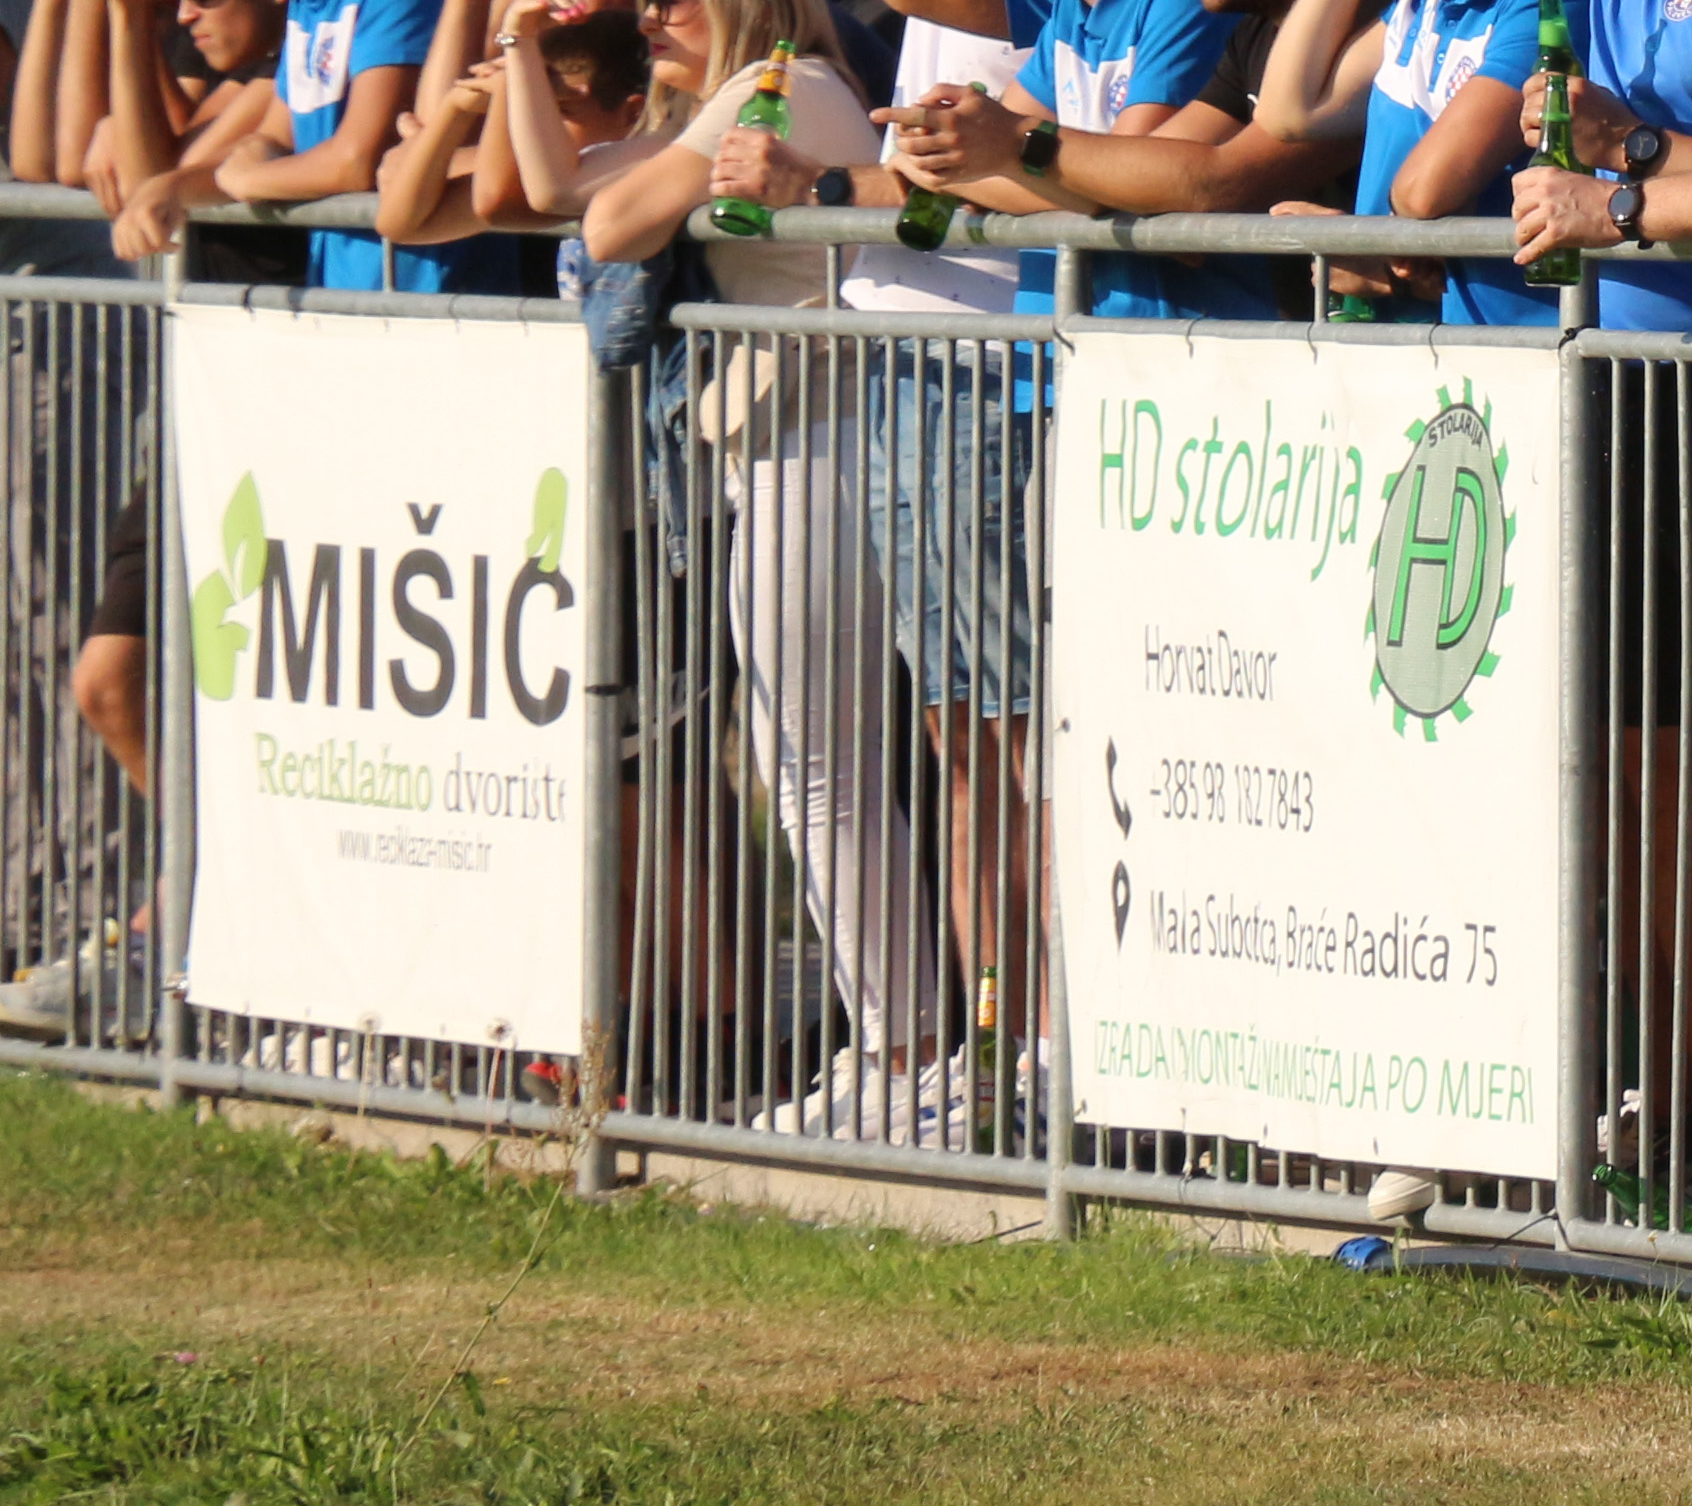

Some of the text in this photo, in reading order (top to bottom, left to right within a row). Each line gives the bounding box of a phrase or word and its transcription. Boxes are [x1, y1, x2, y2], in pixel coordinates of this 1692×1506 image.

[1099, 397, 1363, 583] HD stolarija
[1386, 463, 1488, 651] HD
[1143, 623, 1278, 702] Horvat Davor
[253, 730, 433, 813] Reciklažno
[1234, 763, 1264, 827] 182
[1267, 767, 1314, 833] 7843
[1149, 888, 1202, 956] Mala
[1343, 911, 1451, 985] Radića
[1464, 922, 1499, 988] 75
[1177, 1022, 1262, 1091] MONTAŽ
[1385, 1054, 1428, 1114] PO
[1437, 1058, 1535, 1125] MJERI
